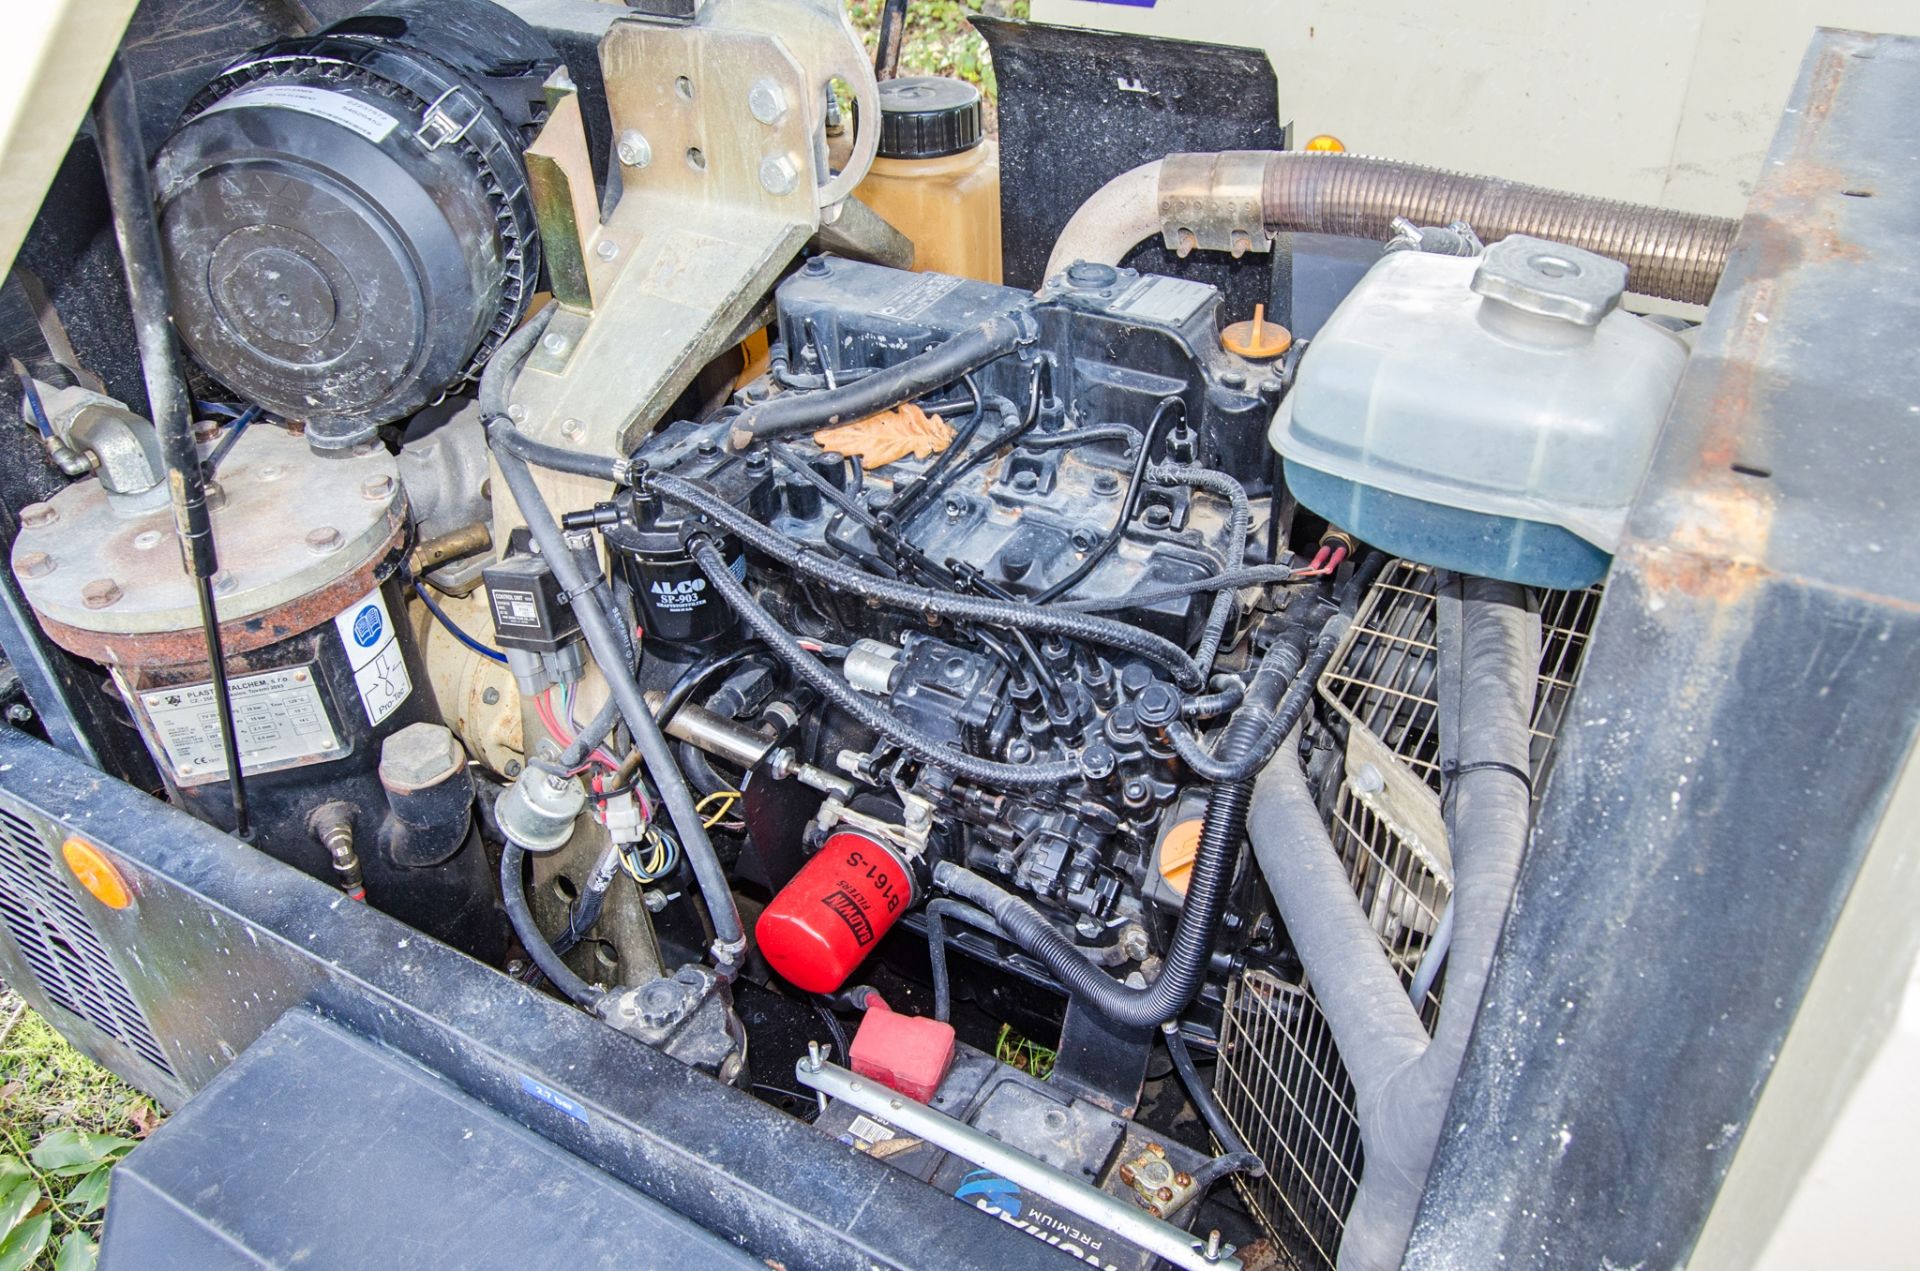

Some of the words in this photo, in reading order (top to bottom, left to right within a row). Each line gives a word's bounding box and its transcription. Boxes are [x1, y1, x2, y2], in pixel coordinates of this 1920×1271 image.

[650, 578, 706, 595] ALCO
[660, 592, 699, 604] SP-903
[379, 687, 406, 715] Pro-Tec
[836, 880, 872, 912] FILTERS
[846, 852, 900, 914] B161-S
[824, 892, 872, 944] BALDWIN
[1027, 1208, 1103, 1251] PREMIUM
